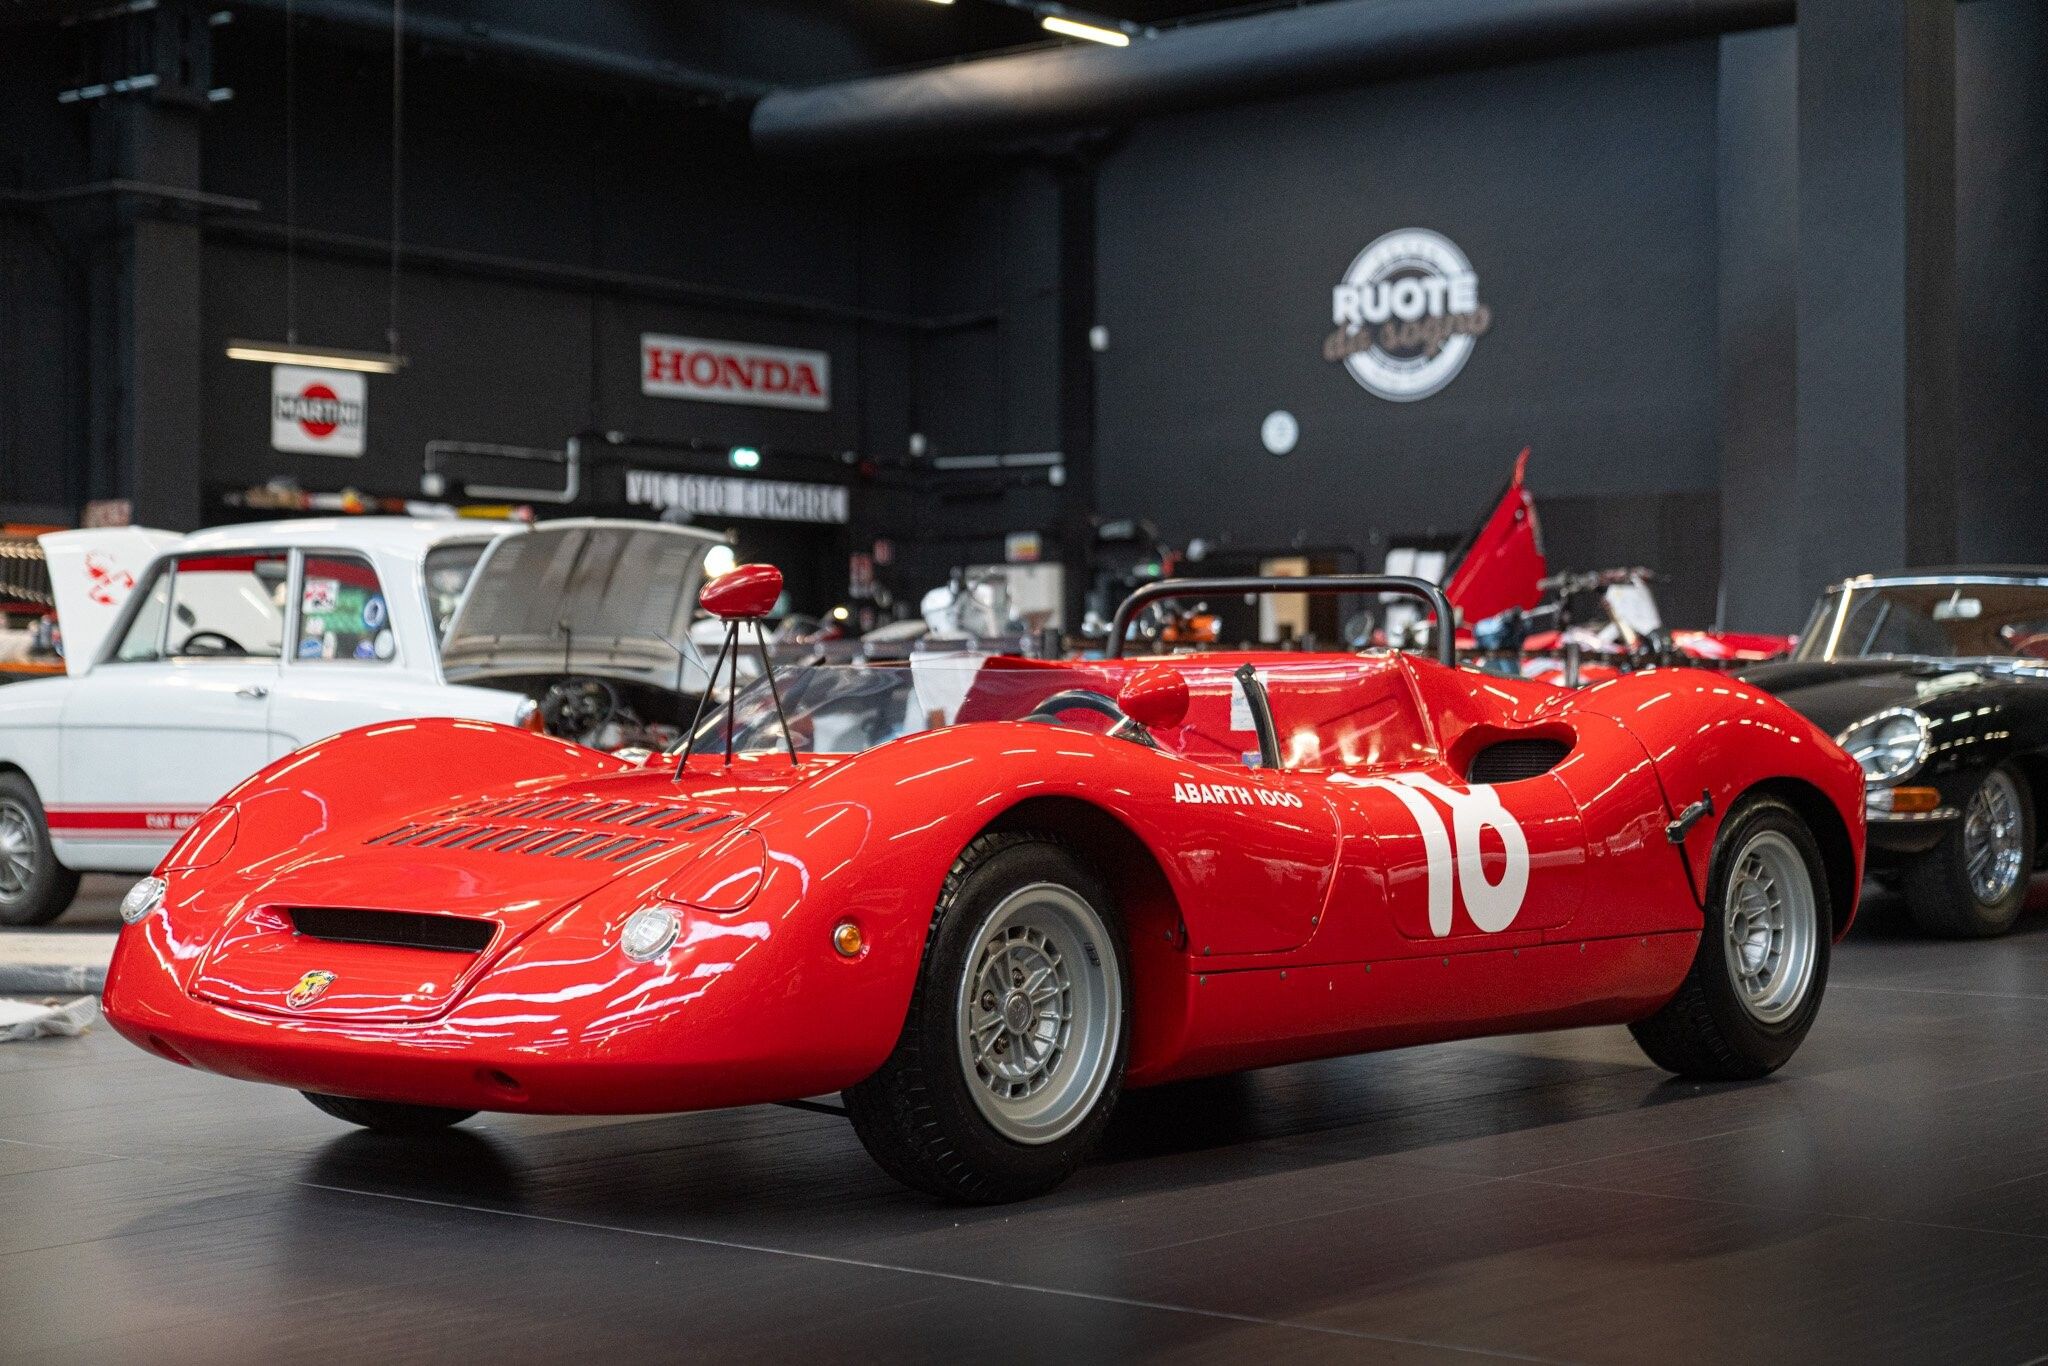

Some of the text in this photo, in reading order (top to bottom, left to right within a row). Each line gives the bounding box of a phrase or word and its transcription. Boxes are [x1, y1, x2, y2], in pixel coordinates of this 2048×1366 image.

[1332, 271, 1478, 334] RUOTE
[646, 346, 822, 397] HONDA
[1173, 782, 1303, 808] ABARTH 1000
